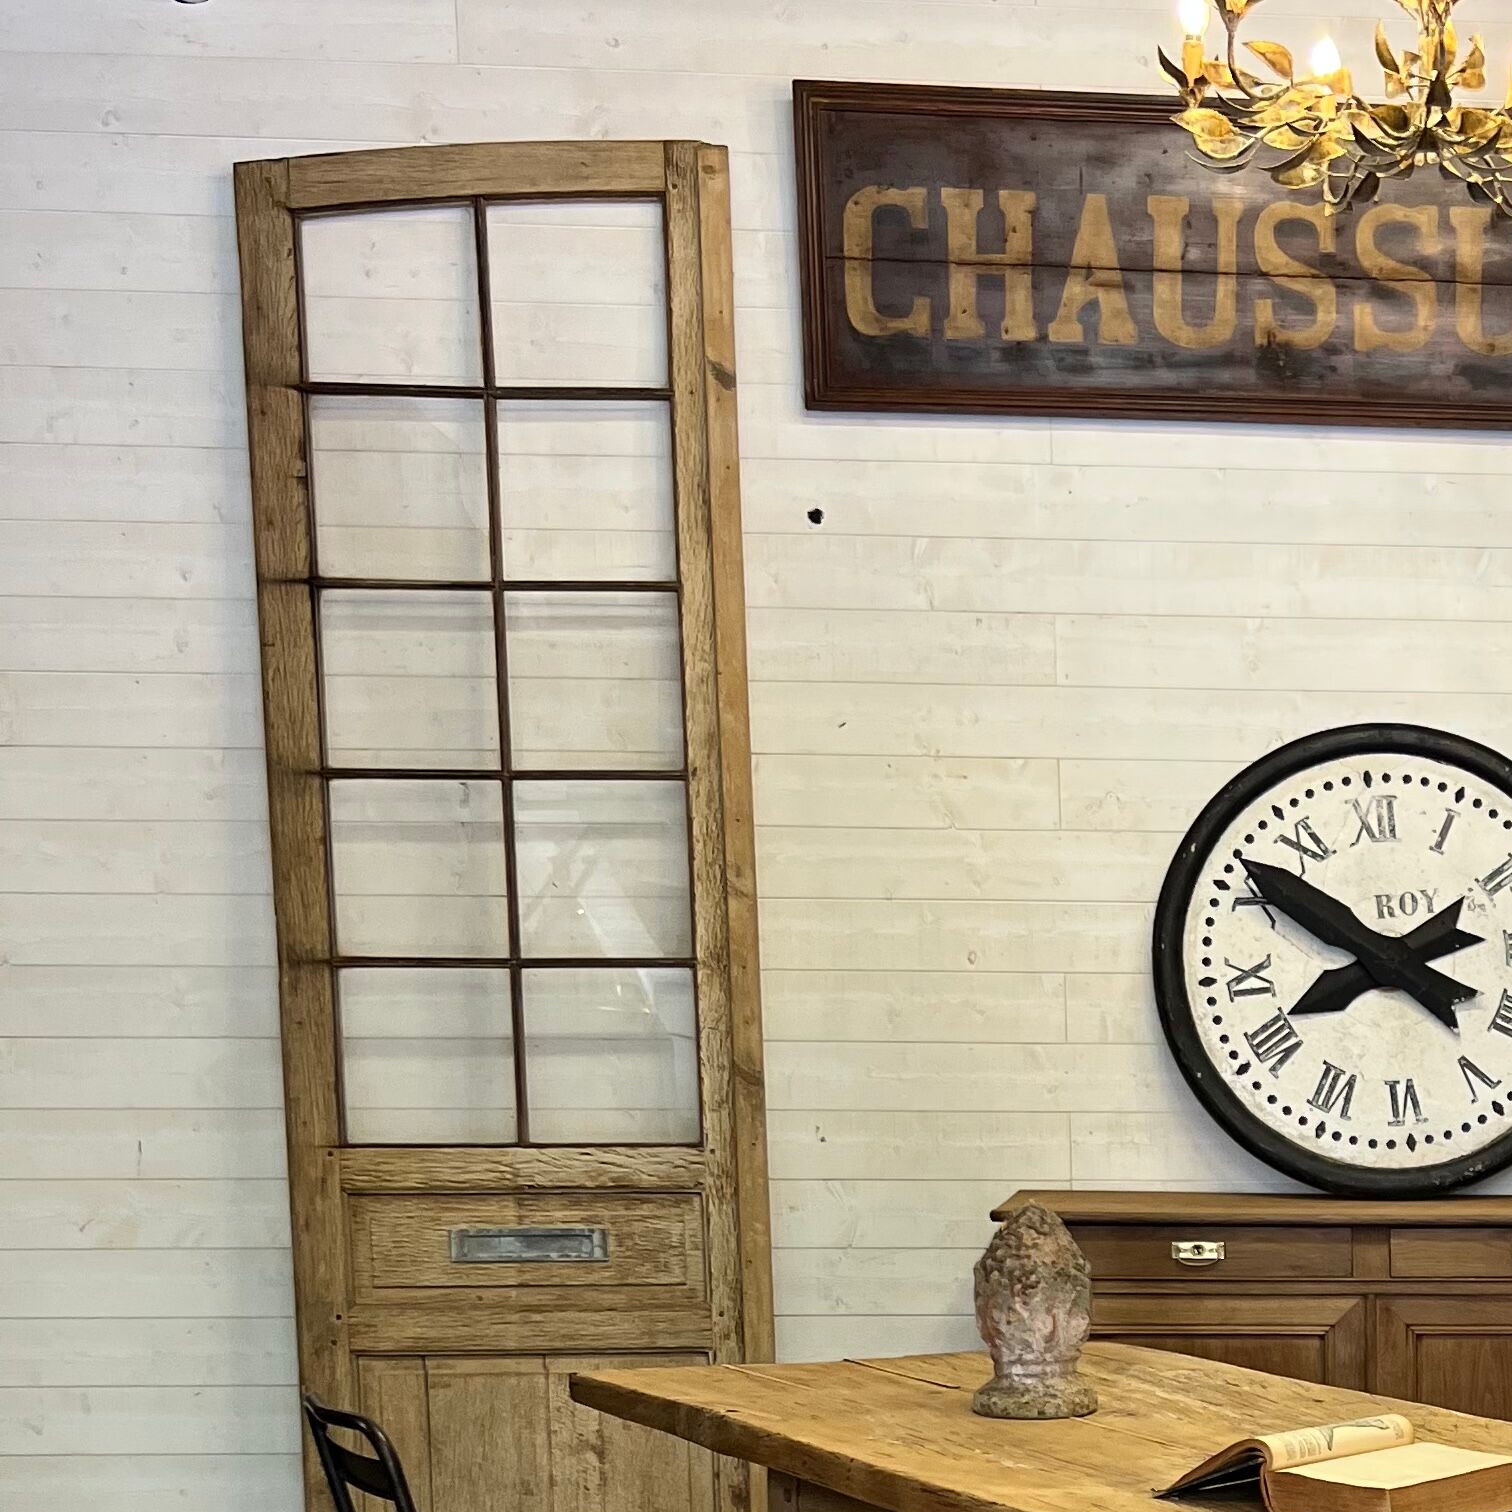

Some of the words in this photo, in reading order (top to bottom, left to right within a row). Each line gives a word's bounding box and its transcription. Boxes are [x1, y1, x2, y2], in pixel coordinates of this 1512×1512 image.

[1346, 794, 1401, 847] XII
[1429, 807, 1461, 855] I
[1273, 815, 1337, 878] XI
[1374, 888, 1438, 919] ROY
[1223, 953, 1277, 1003] IX
